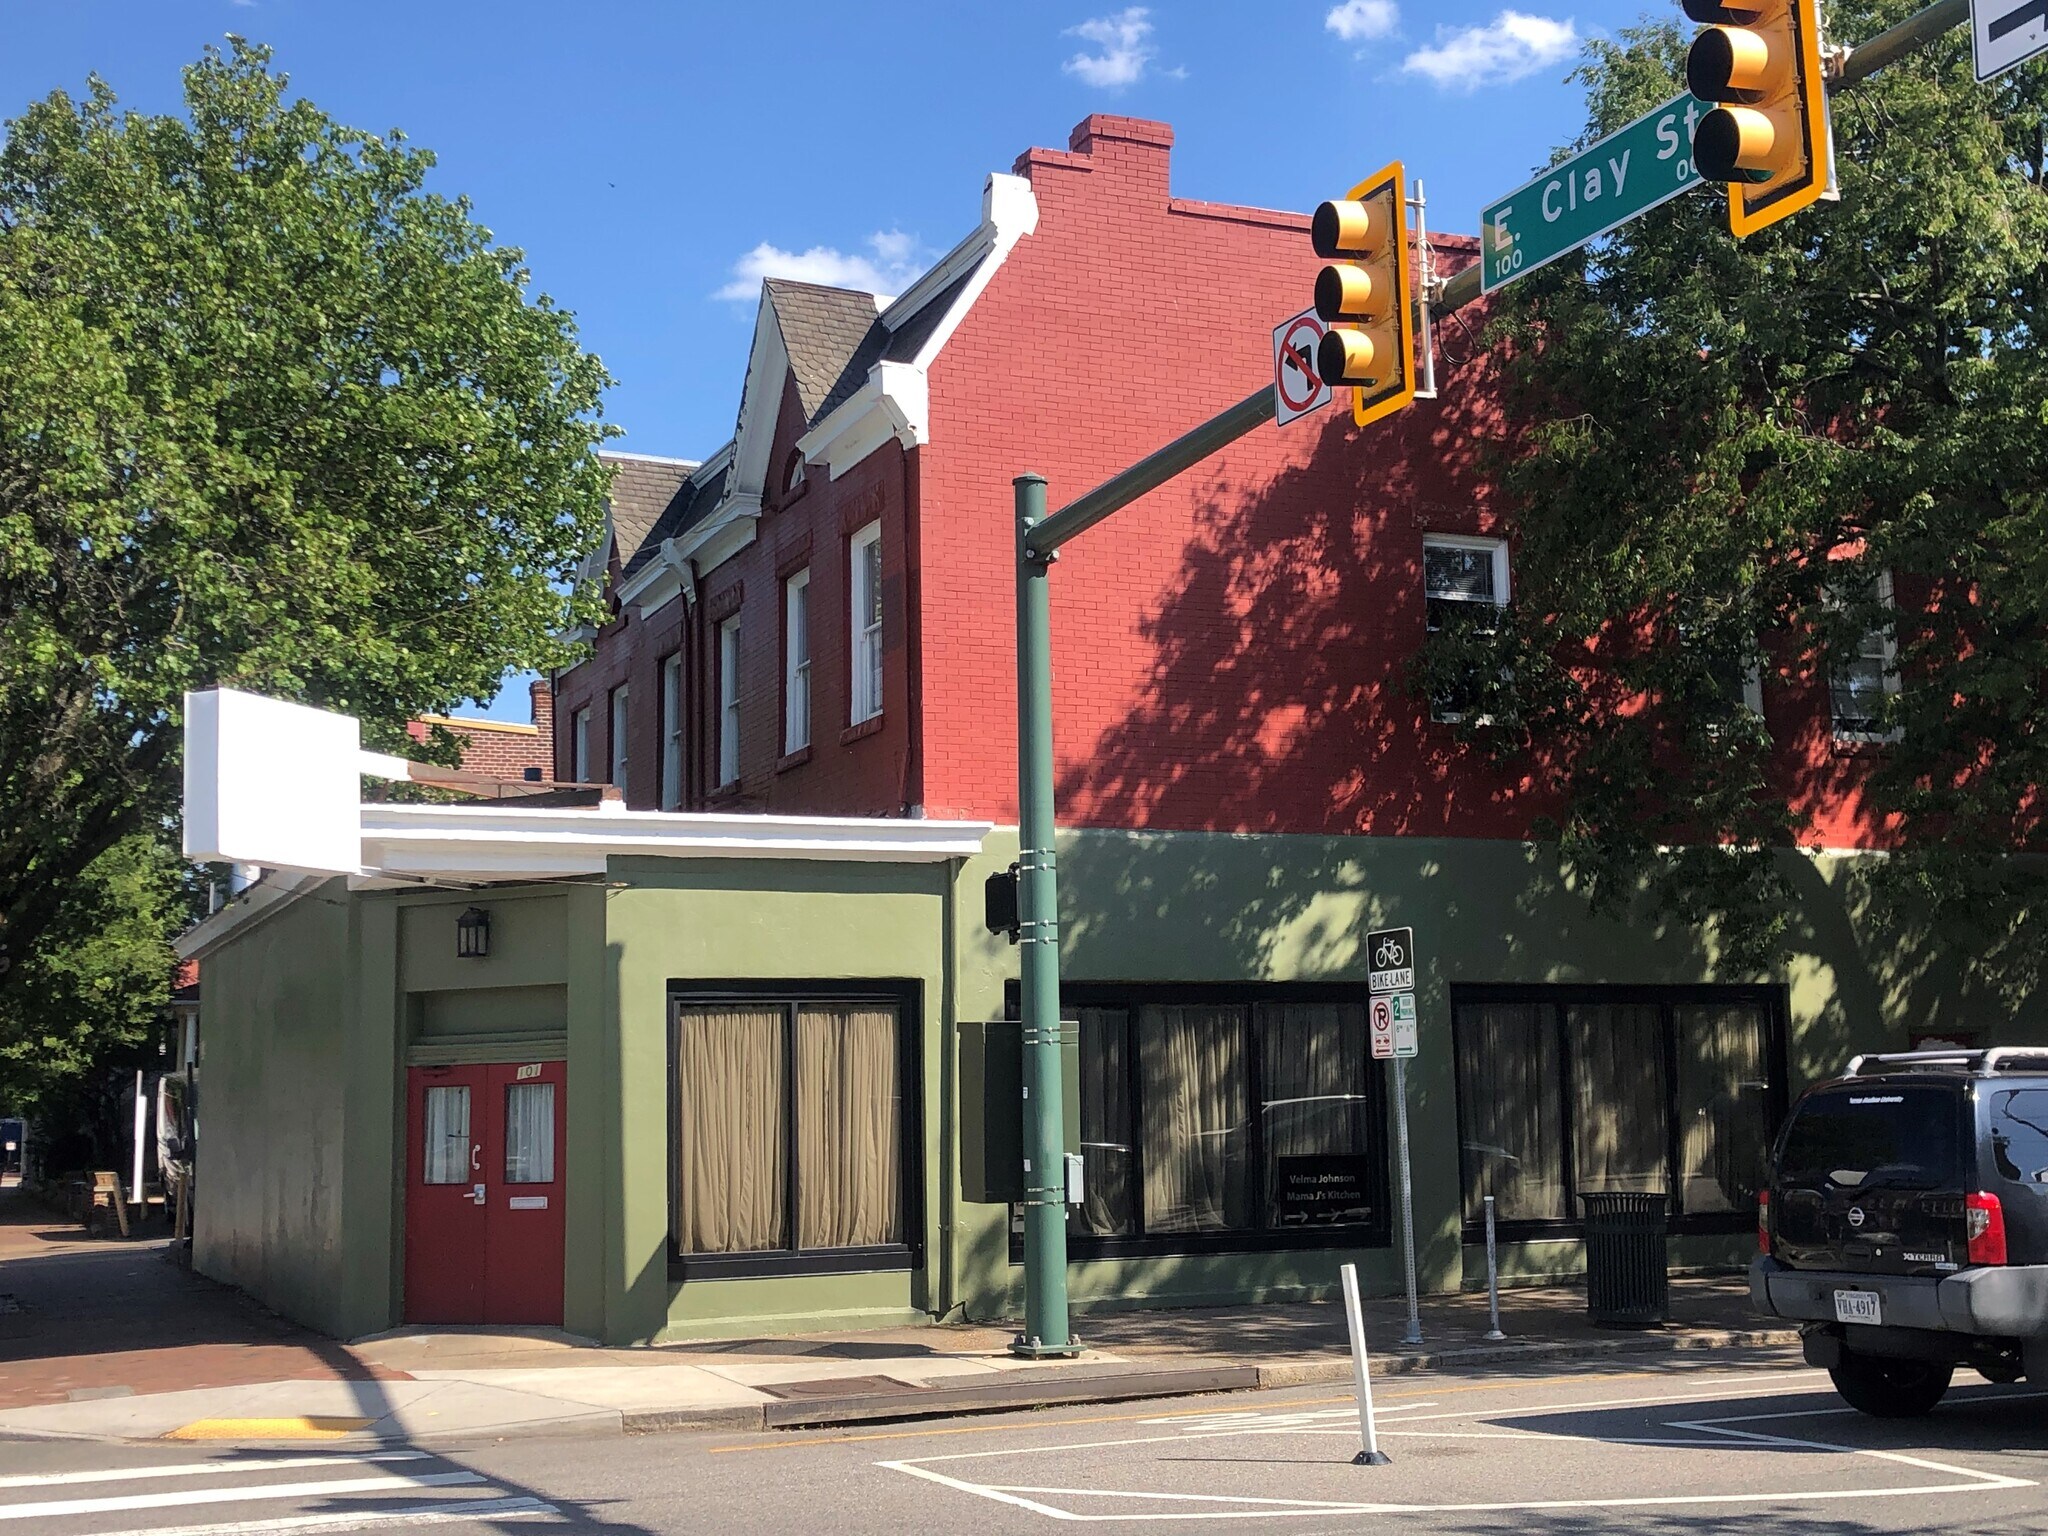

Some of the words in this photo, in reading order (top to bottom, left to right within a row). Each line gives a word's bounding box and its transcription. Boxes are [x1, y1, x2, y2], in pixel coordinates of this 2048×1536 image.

[1494, 206, 1521, 251] E.
[1542, 149, 1630, 222] Clay
[1656, 101, 1699, 160] St
[1495, 248, 1523, 278] 100
[1372, 972, 1389, 988] BIKE
[1390, 970, 1411, 986] LANE
[520, 1065, 539, 1077] 101
[1289, 1174, 1317, 1184] Velma
[1318, 1173, 1356, 1184] Johnson
[1286, 1191, 1314, 1201] Mama
[1315, 1190, 1326, 1201] J's
[1327, 1190, 1360, 1200] Kitchen
